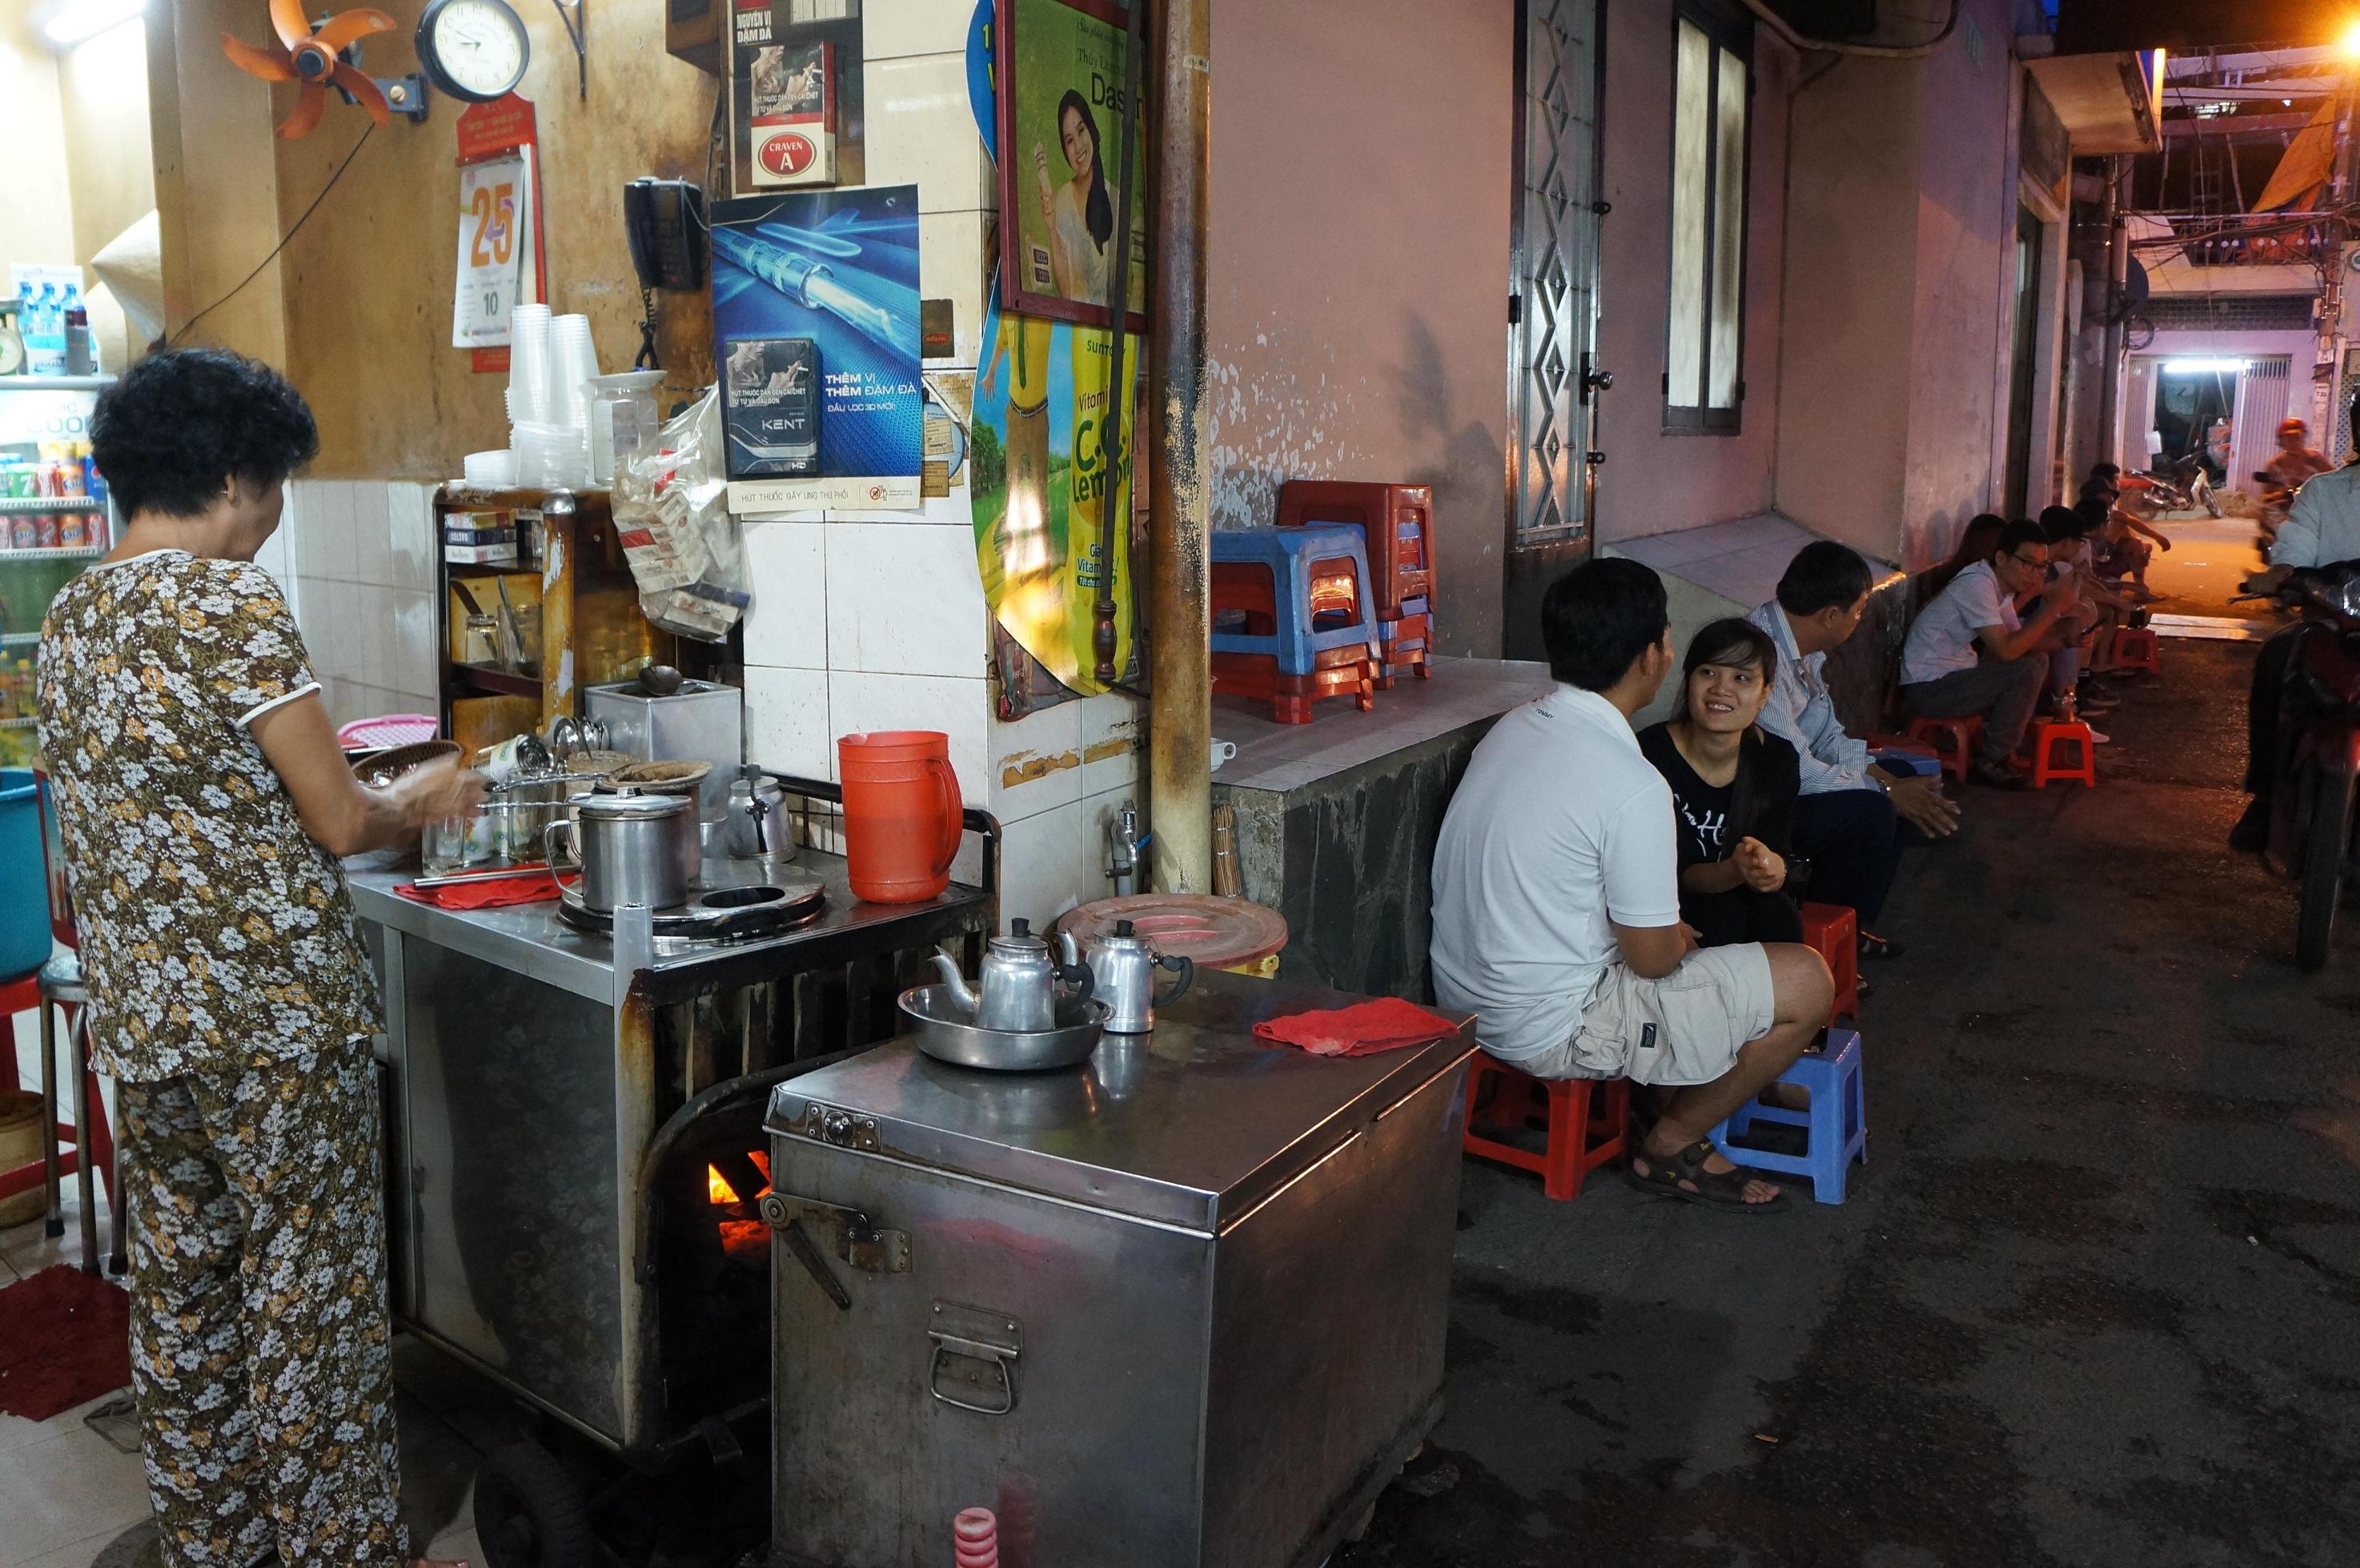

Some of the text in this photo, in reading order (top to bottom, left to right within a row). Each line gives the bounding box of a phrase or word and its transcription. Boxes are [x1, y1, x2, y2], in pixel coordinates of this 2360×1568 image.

[769, 142, 803, 152] CRAVEN
[780, 152, 794, 170] A
[471, 182, 513, 267] 25
[484, 291, 499, 316] 10
[825, 371, 861, 384] THÊM
[825, 384, 861, 397] THÊM
[897, 381, 917, 394] ĐÀ
[762, 419, 805, 431] KENT
[741, 493, 757, 503] HÚT
[759, 491, 783, 501] THUỐC
[786, 491, 801, 500] GÂY
